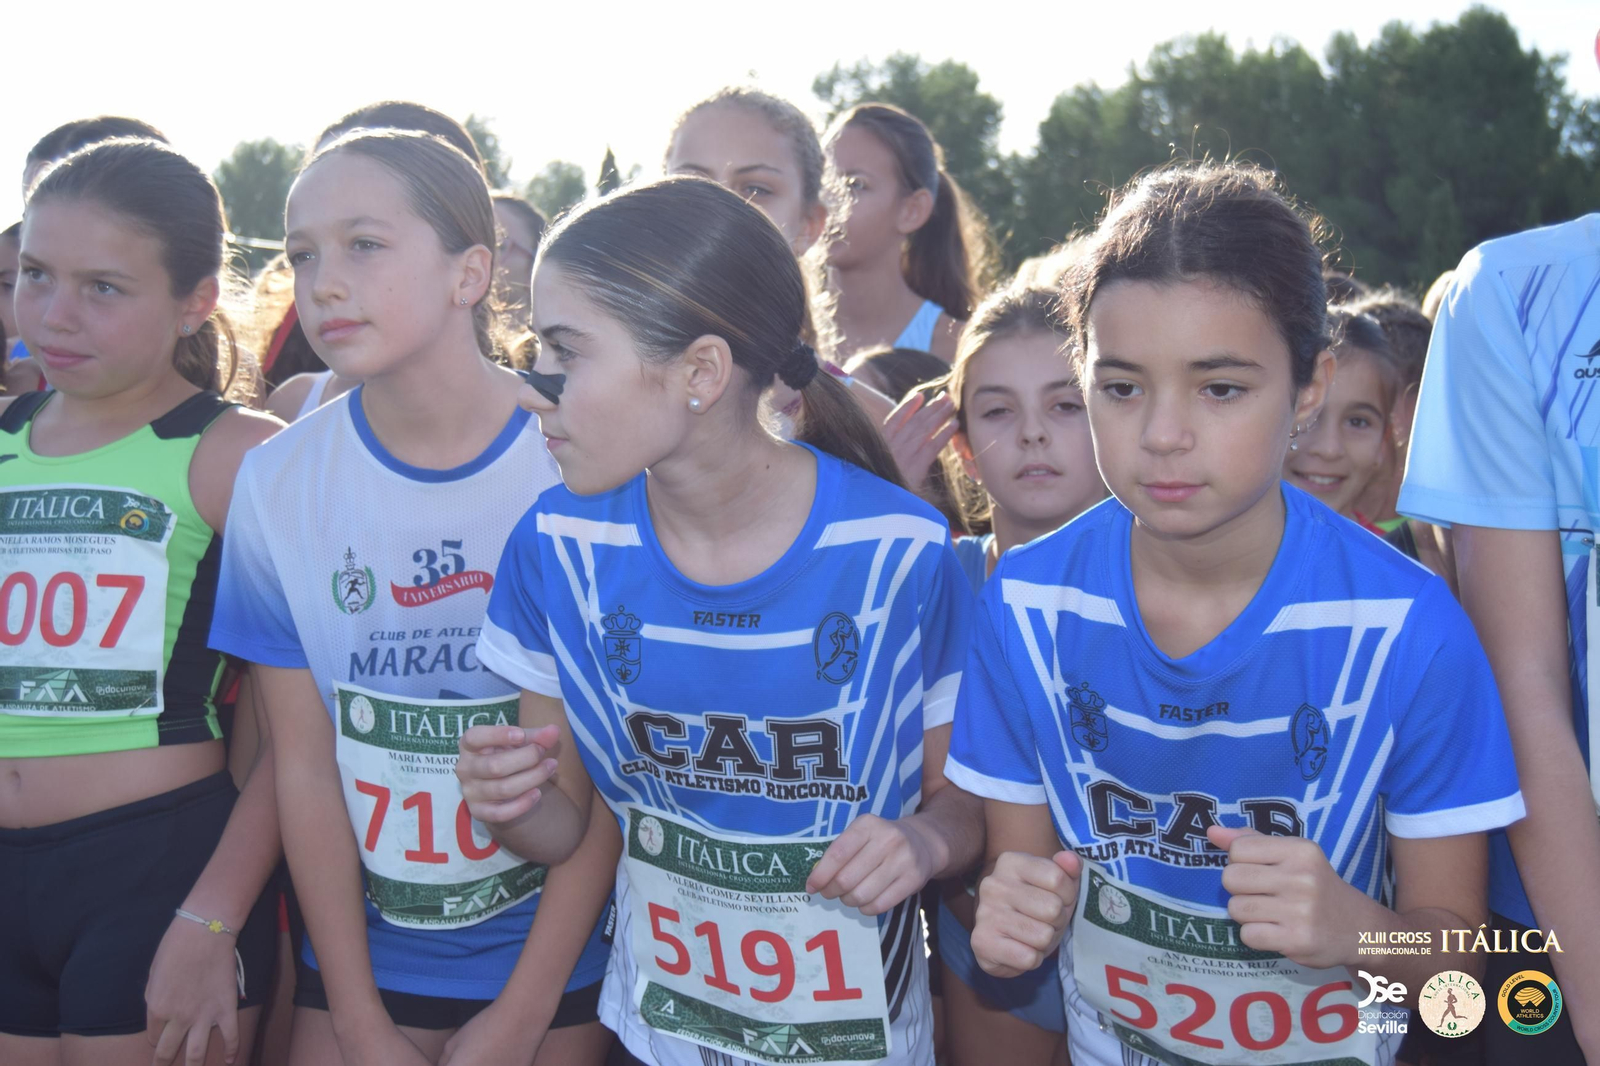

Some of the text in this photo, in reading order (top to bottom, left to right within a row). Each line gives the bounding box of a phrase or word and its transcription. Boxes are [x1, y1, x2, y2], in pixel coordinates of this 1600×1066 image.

[9, 491, 105, 519] ITÁLICA
[9, 547, 47, 555] ATLETISMO
[48, 547, 72, 555] BRISAS
[74, 547, 88, 555] DEL
[31, 536, 62, 545] RAMOS
[64, 536, 116, 545] MOSEGUES
[412, 539, 466, 588] 35
[403, 572, 484, 603] ANIVERSARIO
[693, 610, 761, 629] FASTER
[369, 631, 406, 641] CLUB
[412, 629, 433, 639] DE
[1159, 702, 1230, 723] FASTER
[625, 711, 849, 782] CAR
[400, 765, 450, 775] ATLETISMO
[621, 762, 868, 802] CLUB ATLETISMO RINCONADA
[676, 833, 790, 876] ITÁLICA
[678, 860, 726, 879] INTERNATIONAL
[729, 874, 752, 882] CROSS
[666, 873, 811, 904] VALERIA GOMEZ SEVILLANO
[677, 887, 798, 914] CLUB ATLETISMO RINCONADA
[423, 917, 466, 925] ANDALUZA
[648, 901, 862, 1003] 5191
[1150, 932, 1218, 951] INTERNATIONAL
[1147, 956, 1299, 978] CLUB ATLETISMO RINCONADA
[1164, 952, 1280, 970] ANA CALERA RUIZ
[1105, 964, 1359, 1050] 5206
[676, 1028, 723, 1050] FEDERACIÓN
[779, 1056, 824, 1065] ATLETISMO
[831, 1032, 875, 1043] docunova
